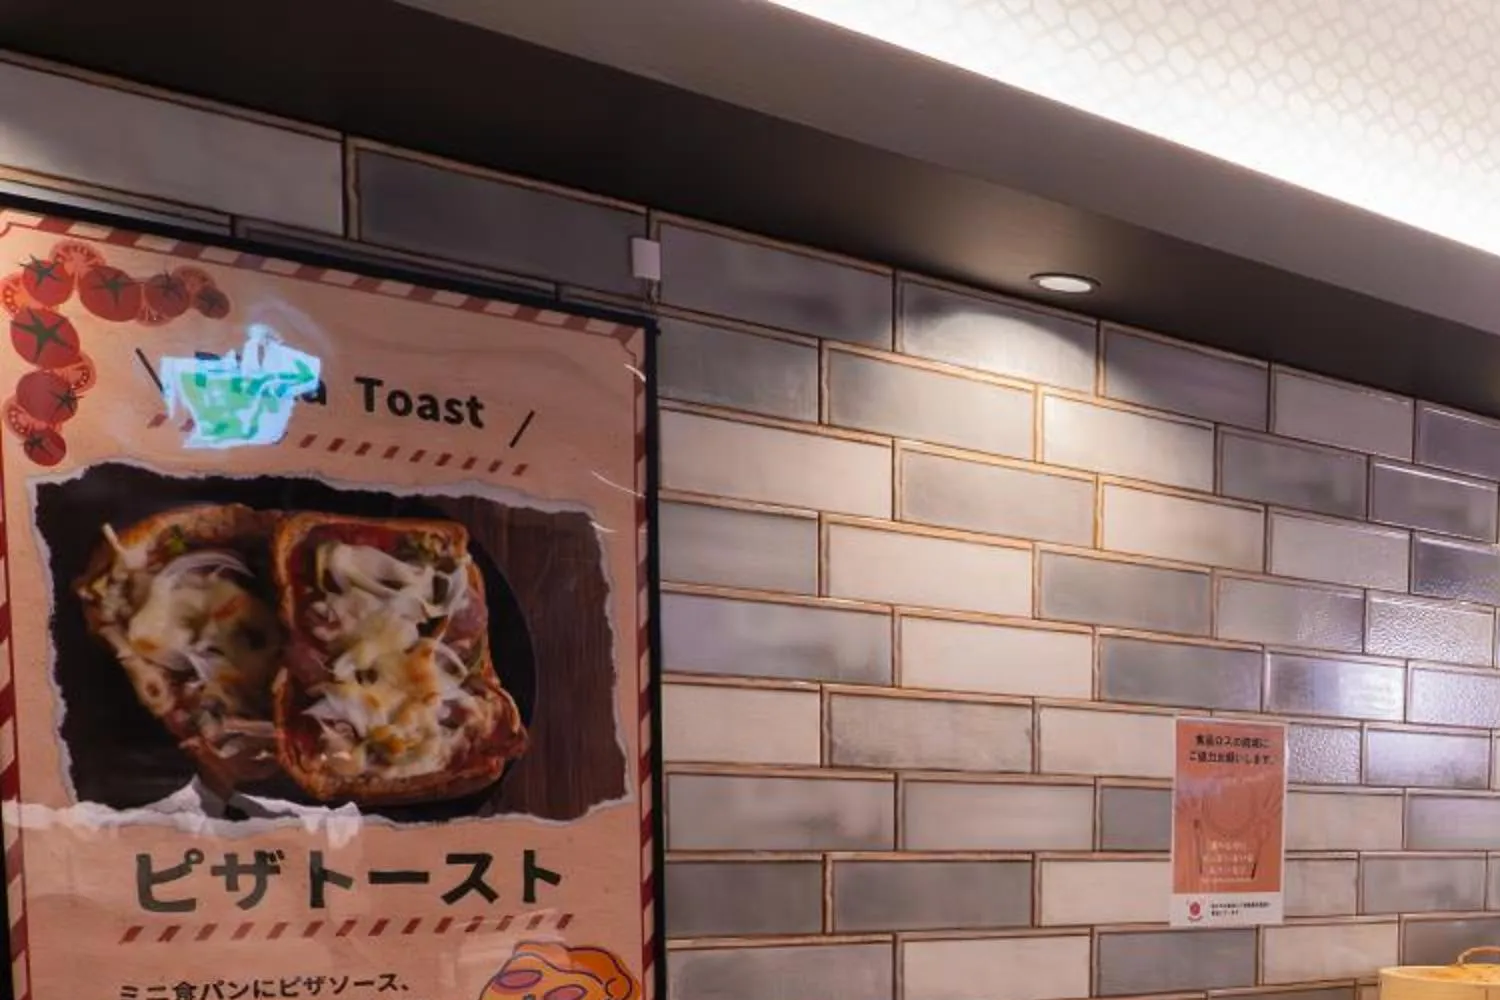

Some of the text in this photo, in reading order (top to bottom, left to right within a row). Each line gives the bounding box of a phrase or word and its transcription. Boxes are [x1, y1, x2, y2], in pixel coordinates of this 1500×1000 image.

[355, 376, 485, 429] Toast
[134, 849, 563, 914] ピザトースト
